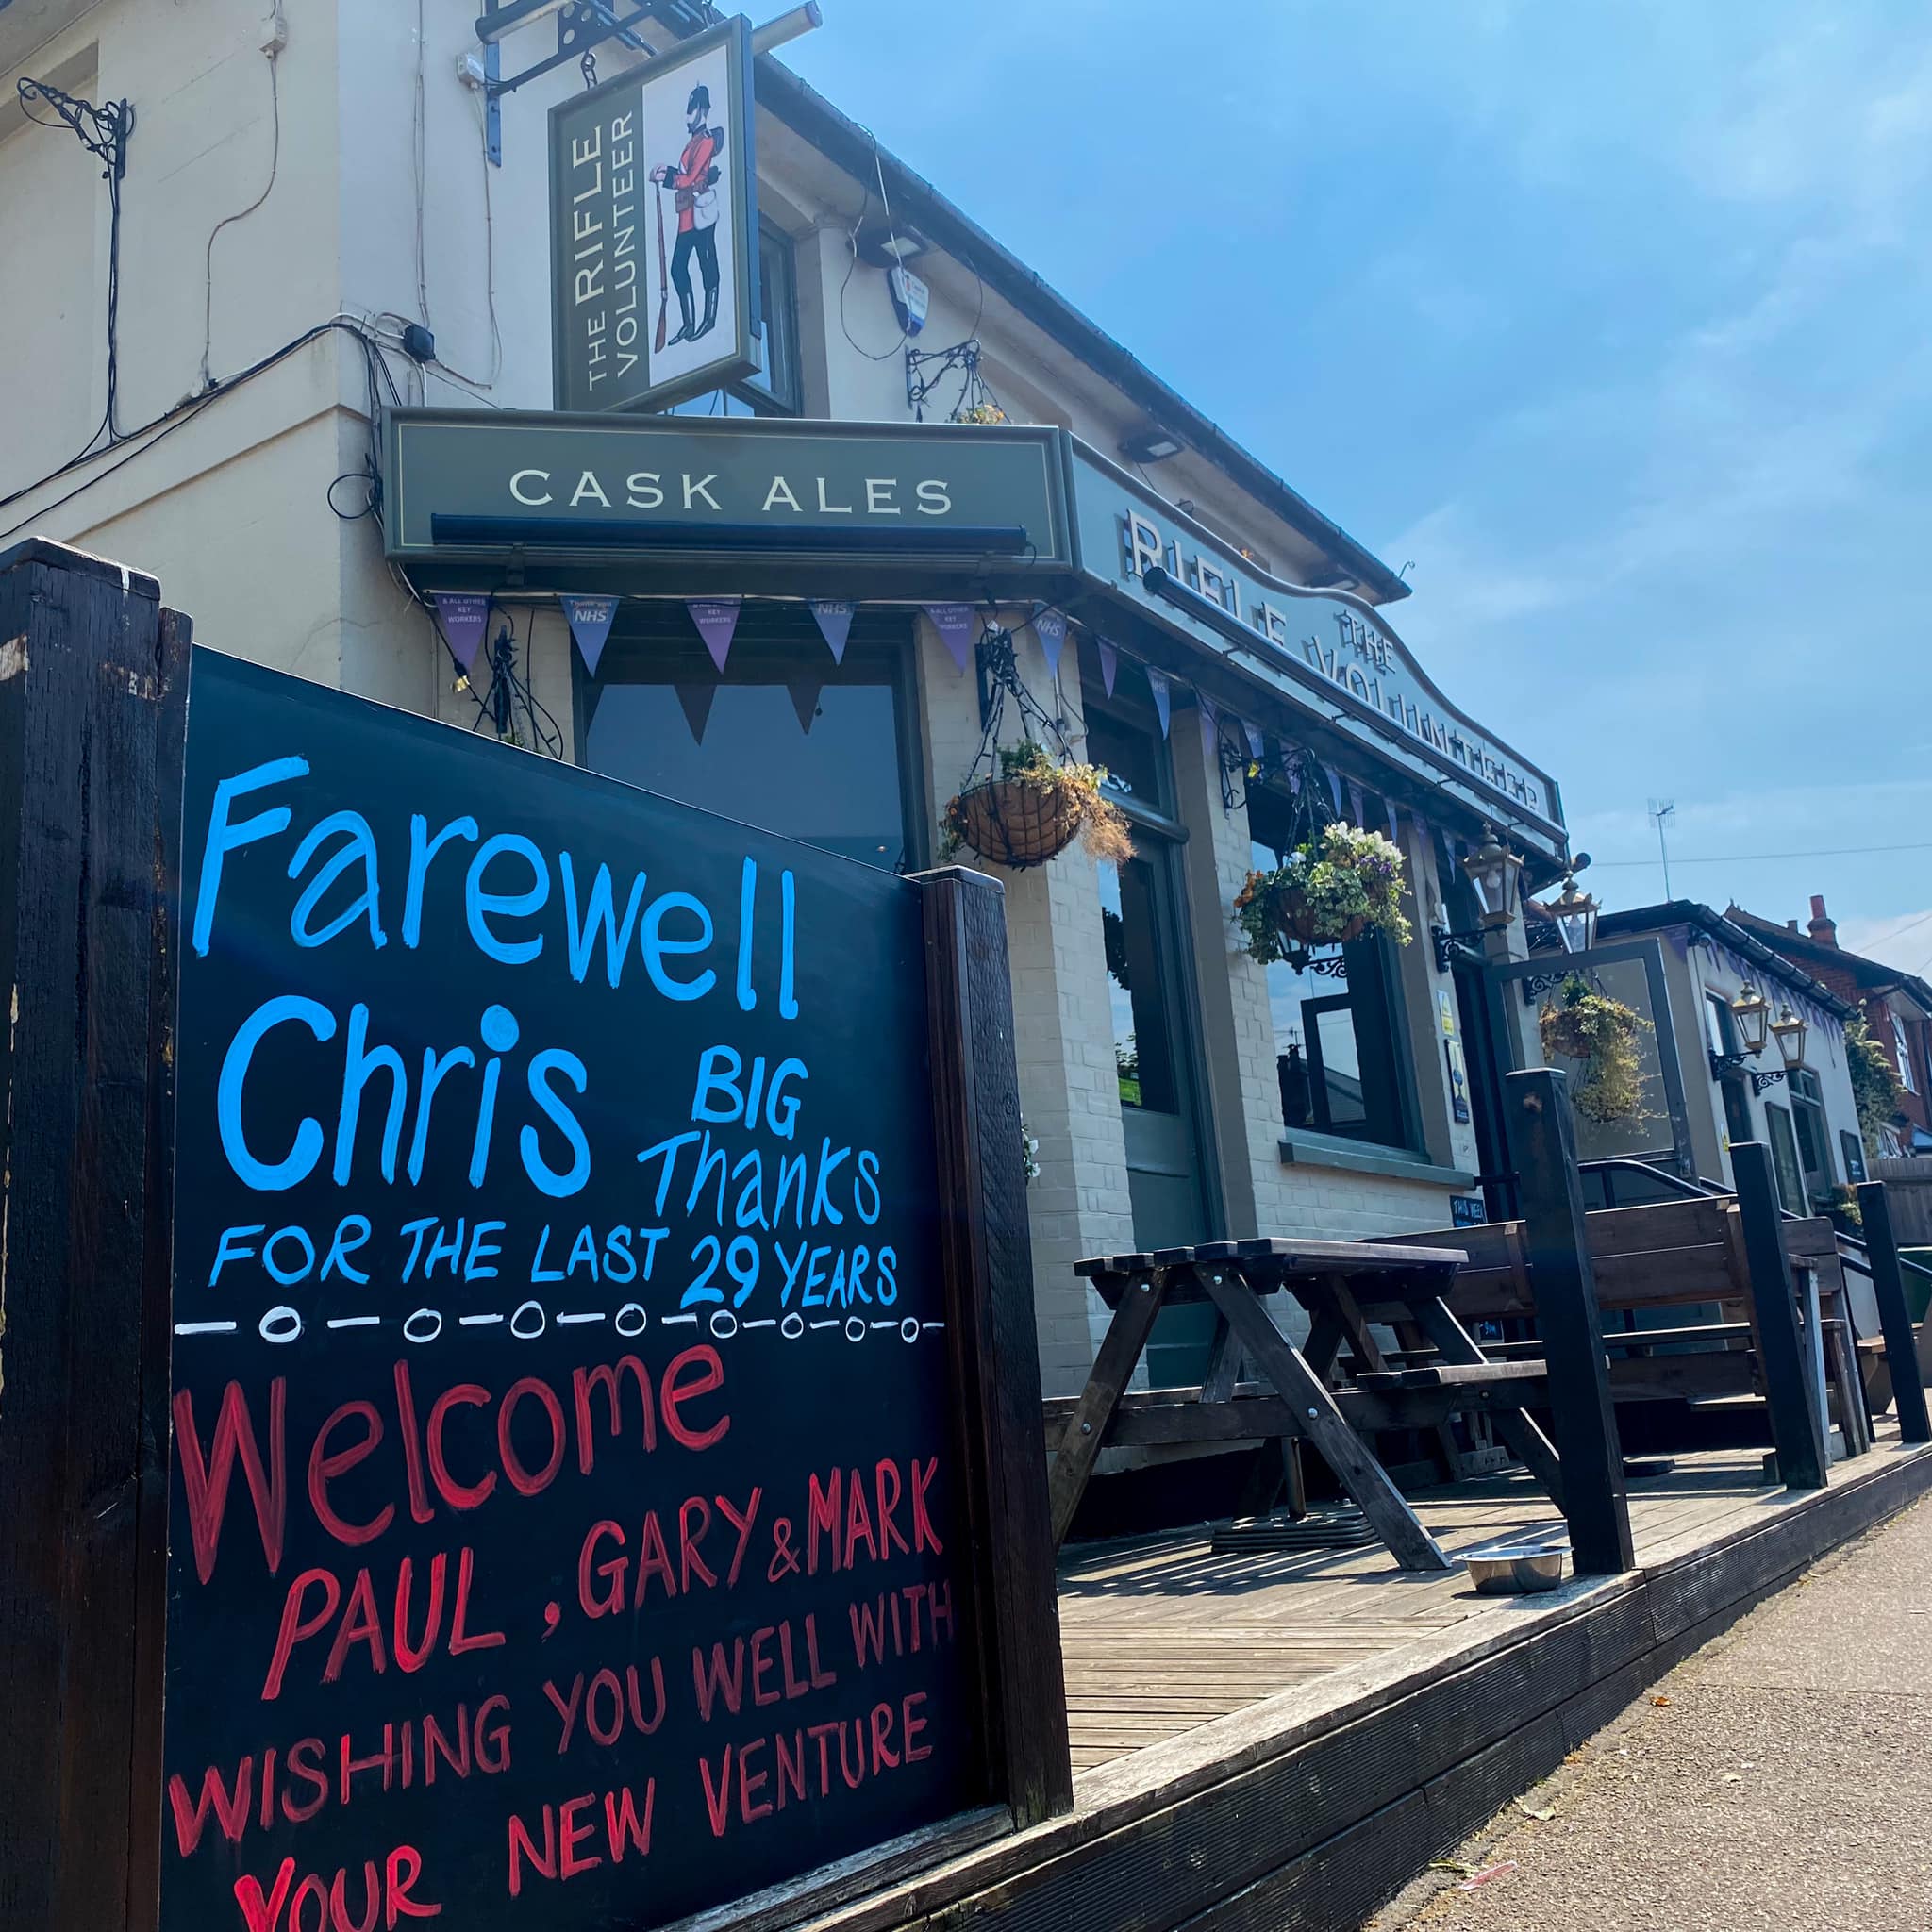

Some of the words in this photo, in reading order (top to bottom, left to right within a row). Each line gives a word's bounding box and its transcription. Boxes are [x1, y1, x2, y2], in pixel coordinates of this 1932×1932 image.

[572, 125, 605, 307] RIFLE
[611, 110, 639, 378] VOLUNTEER
[587, 309, 606, 391] THE
[509, 468, 723, 510] CASK
[761, 475, 952, 515] ALES
[448, 614, 482, 624] WORKERS
[575, 610, 607, 623] NHS
[818, 603, 846, 615] NHS
[1037, 619, 1059, 636] NHS
[1344, 609, 1396, 674] THE
[192, 755, 799, 1020] Farewell
[217, 994, 591, 1198] Chris
[691, 1044, 808, 1140] BIG
[636, 1130, 881, 1231] Thanks
[208, 1214, 371, 1287] FOR
[400, 1217, 507, 1283] THE
[530, 1224, 670, 1283] LAST
[679, 1235, 760, 1309] 29
[774, 1241, 898, 1308] YEARS
[172, 1343, 731, 1586] Welcome
[578, 1487, 762, 1618] GARY
[767, 1517, 801, 1582] &
[807, 1457, 943, 1574] MARK
[169, 1695, 510, 1857] WISHING
[543, 1657, 666, 1753] YOU
[693, 1614, 836, 1721] WELL
[850, 1579, 954, 1669] WITH
[234, 1845, 441, 1932] YOUR
[508, 1778, 655, 1895] NEW
[700, 1693, 932, 1836] VENTURE
